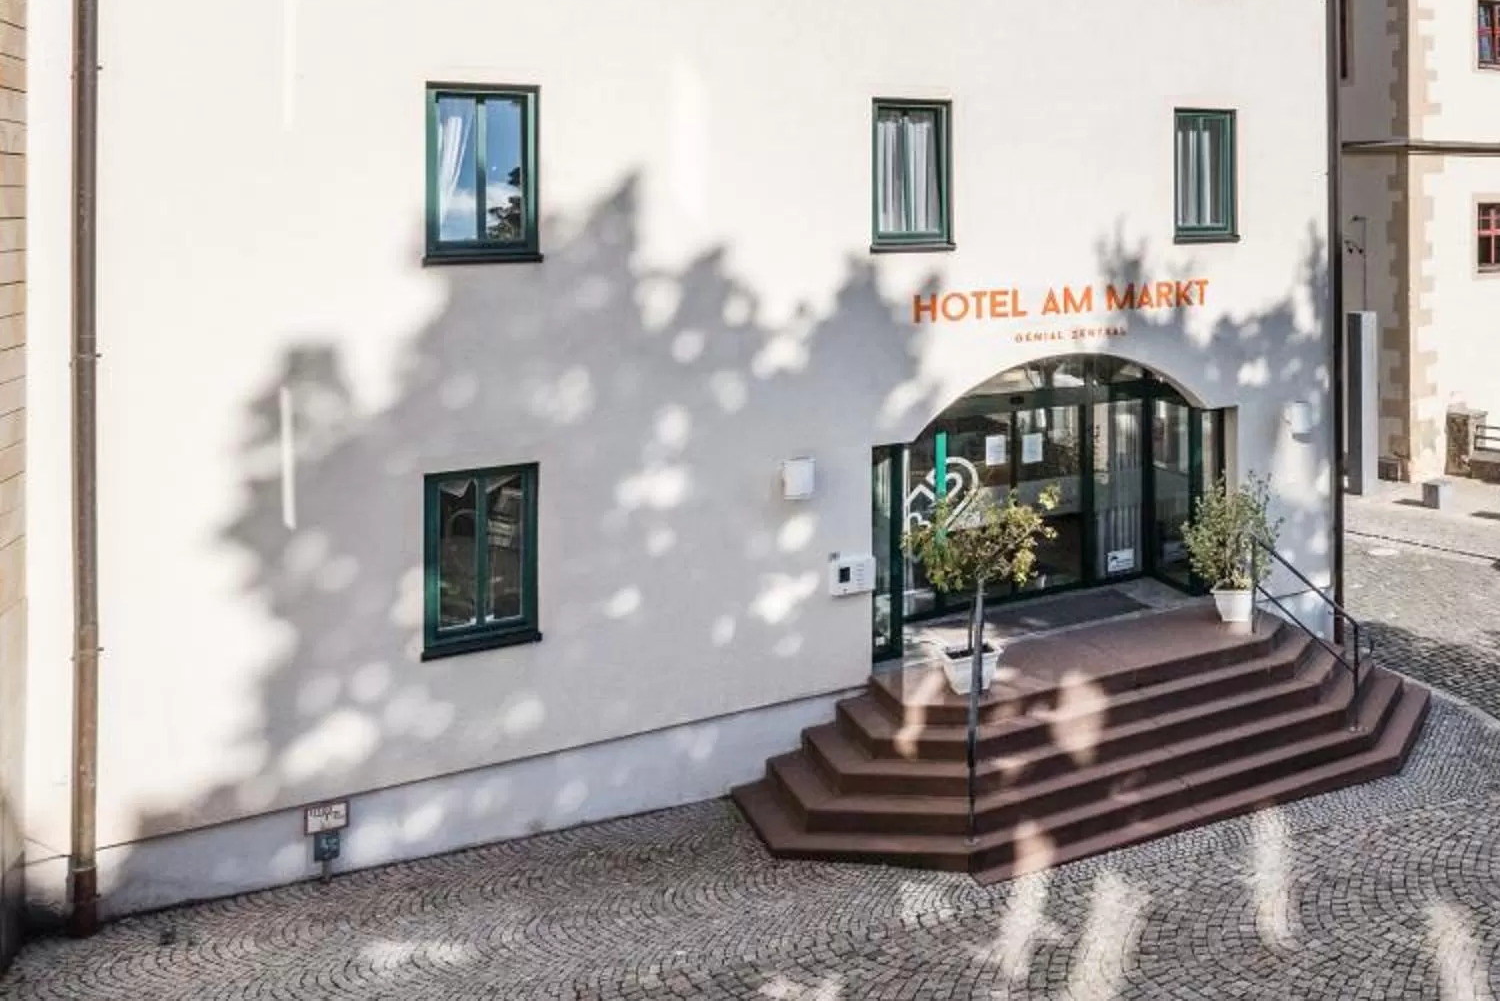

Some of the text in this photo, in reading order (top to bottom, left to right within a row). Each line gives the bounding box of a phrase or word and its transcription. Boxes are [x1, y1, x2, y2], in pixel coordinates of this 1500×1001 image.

[913, 278, 1209, 324] HOTEL AM MARKT
